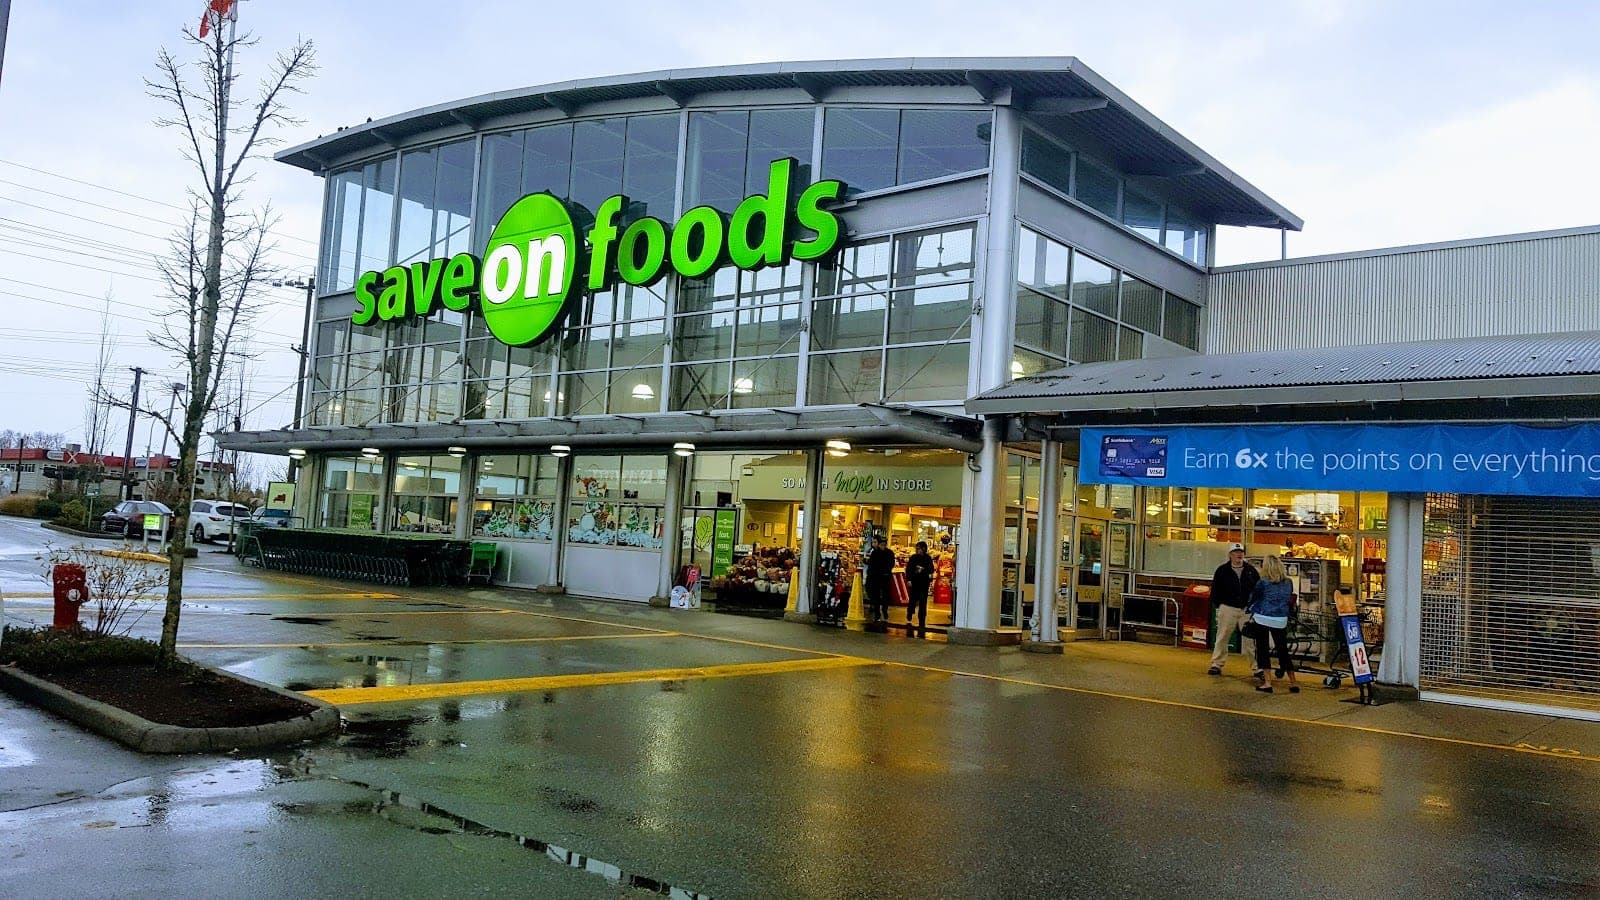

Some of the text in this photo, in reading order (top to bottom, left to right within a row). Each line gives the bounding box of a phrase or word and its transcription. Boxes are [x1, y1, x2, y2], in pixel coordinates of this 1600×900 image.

[352, 157, 842, 327] save on foods
[1184, 447, 1600, 480] Earn 6x the points on everything
[781, 478, 796, 489] SO
[798, 477, 829, 489] MH
[876, 478, 889, 491] IN
[893, 479, 932, 491] STORE
